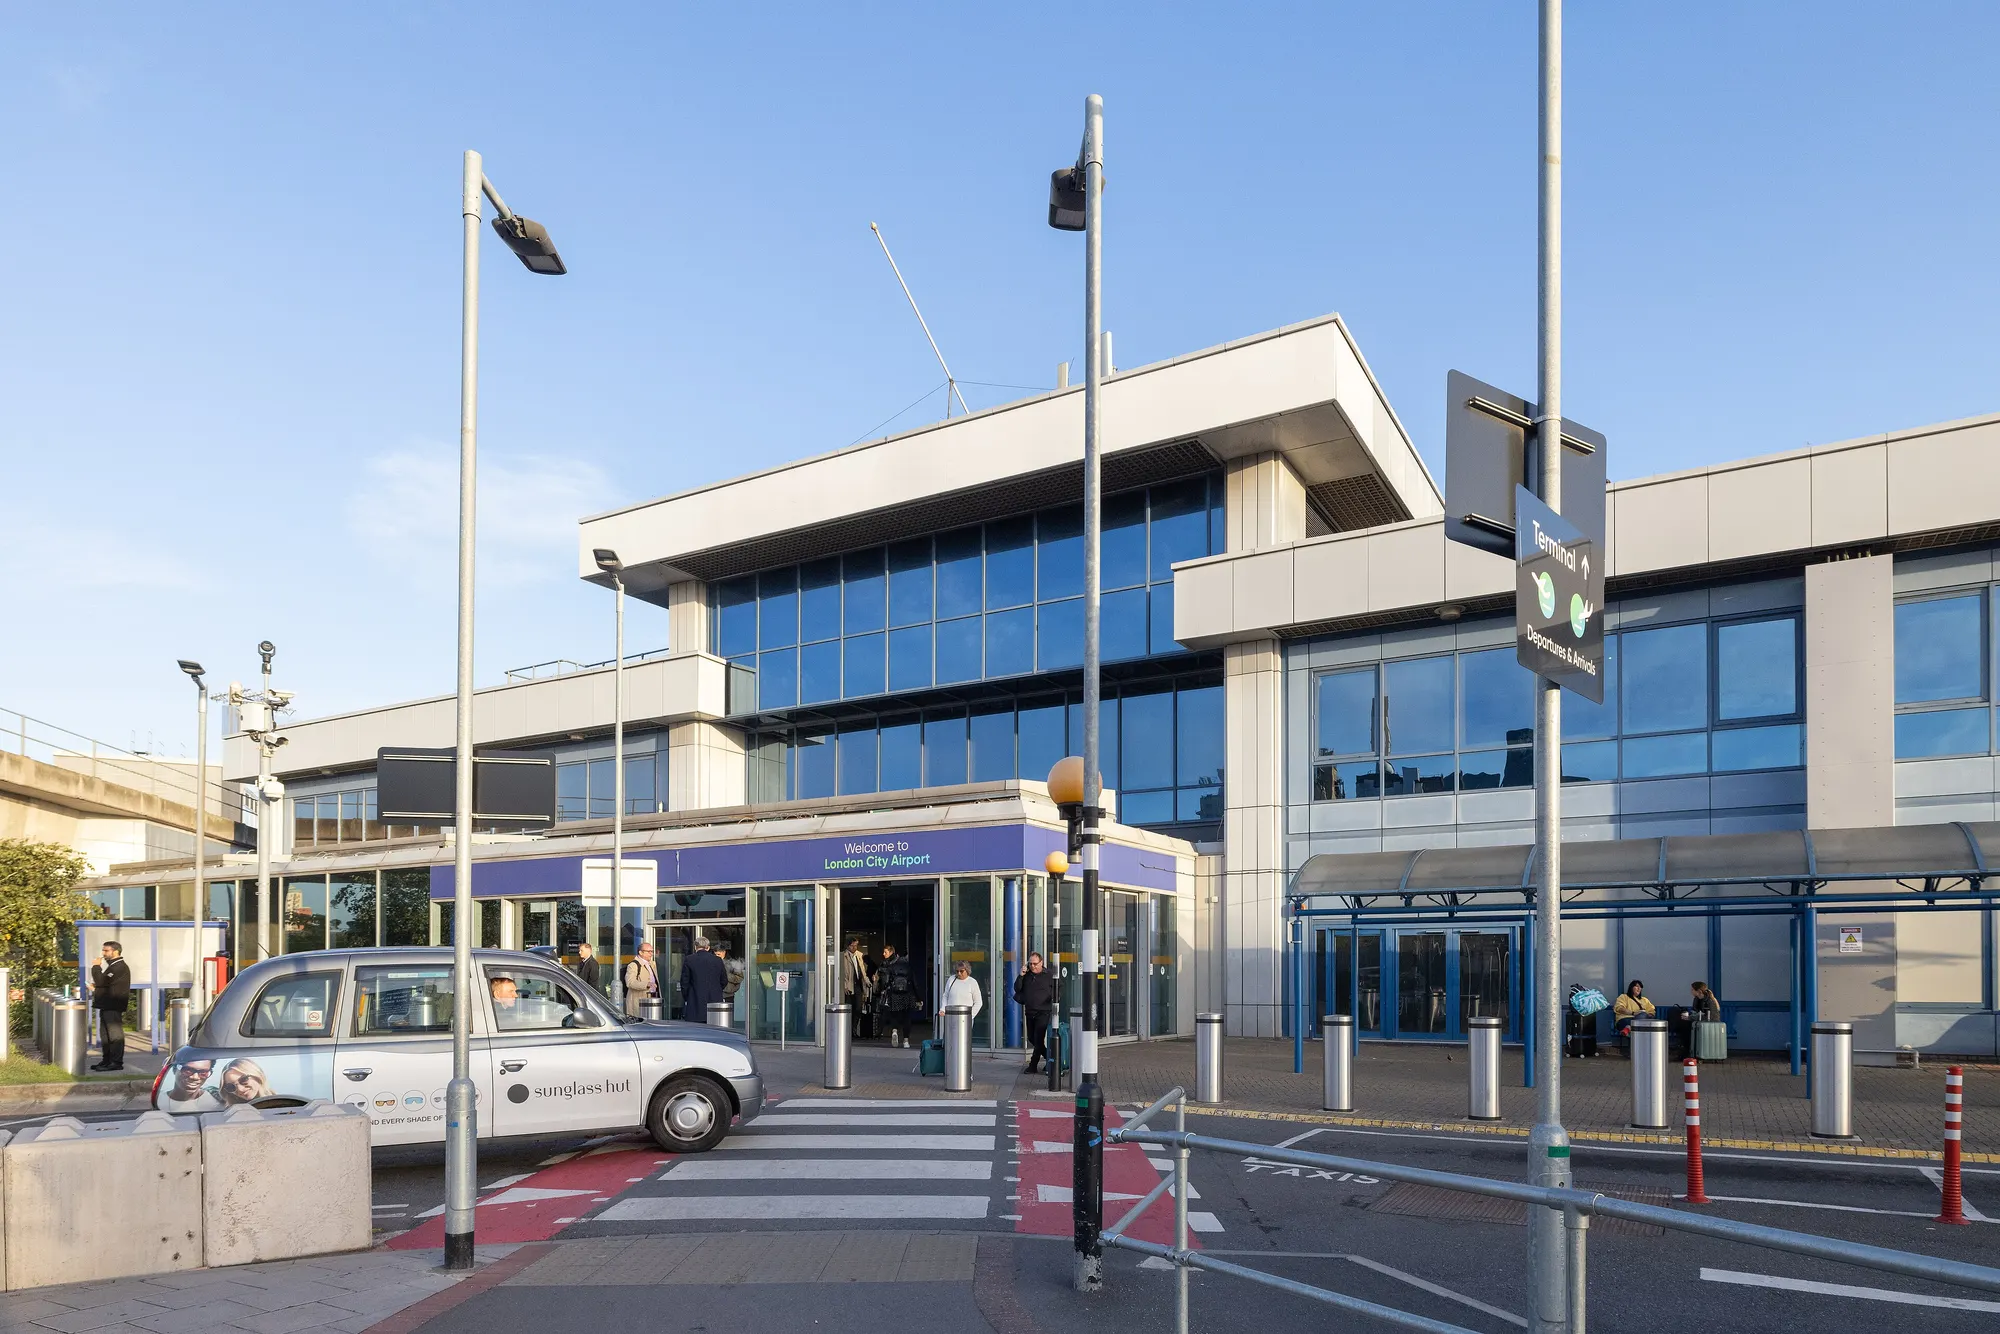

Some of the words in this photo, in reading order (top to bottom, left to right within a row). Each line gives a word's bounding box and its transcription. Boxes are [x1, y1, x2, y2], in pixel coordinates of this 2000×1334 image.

[1532, 519, 1576, 573] Terminal
[1527, 623, 1567, 660] Departures
[1567, 647, 1573, 664] &
[1573, 650, 1596, 676] Arrivals
[844, 841, 895, 855] Welcome
[897, 840, 909, 851] to
[824, 857, 864, 870] London
[866, 855, 889, 869] City
[891, 853, 931, 868] Airport
[534, 1081, 603, 1100] sunglass
[606, 1079, 631, 1093] hut
[381, 1117, 406, 1125] EVERY
[406, 1115, 432, 1123] SHADE
[1244, 1163, 1380, 1184] TAXIS
